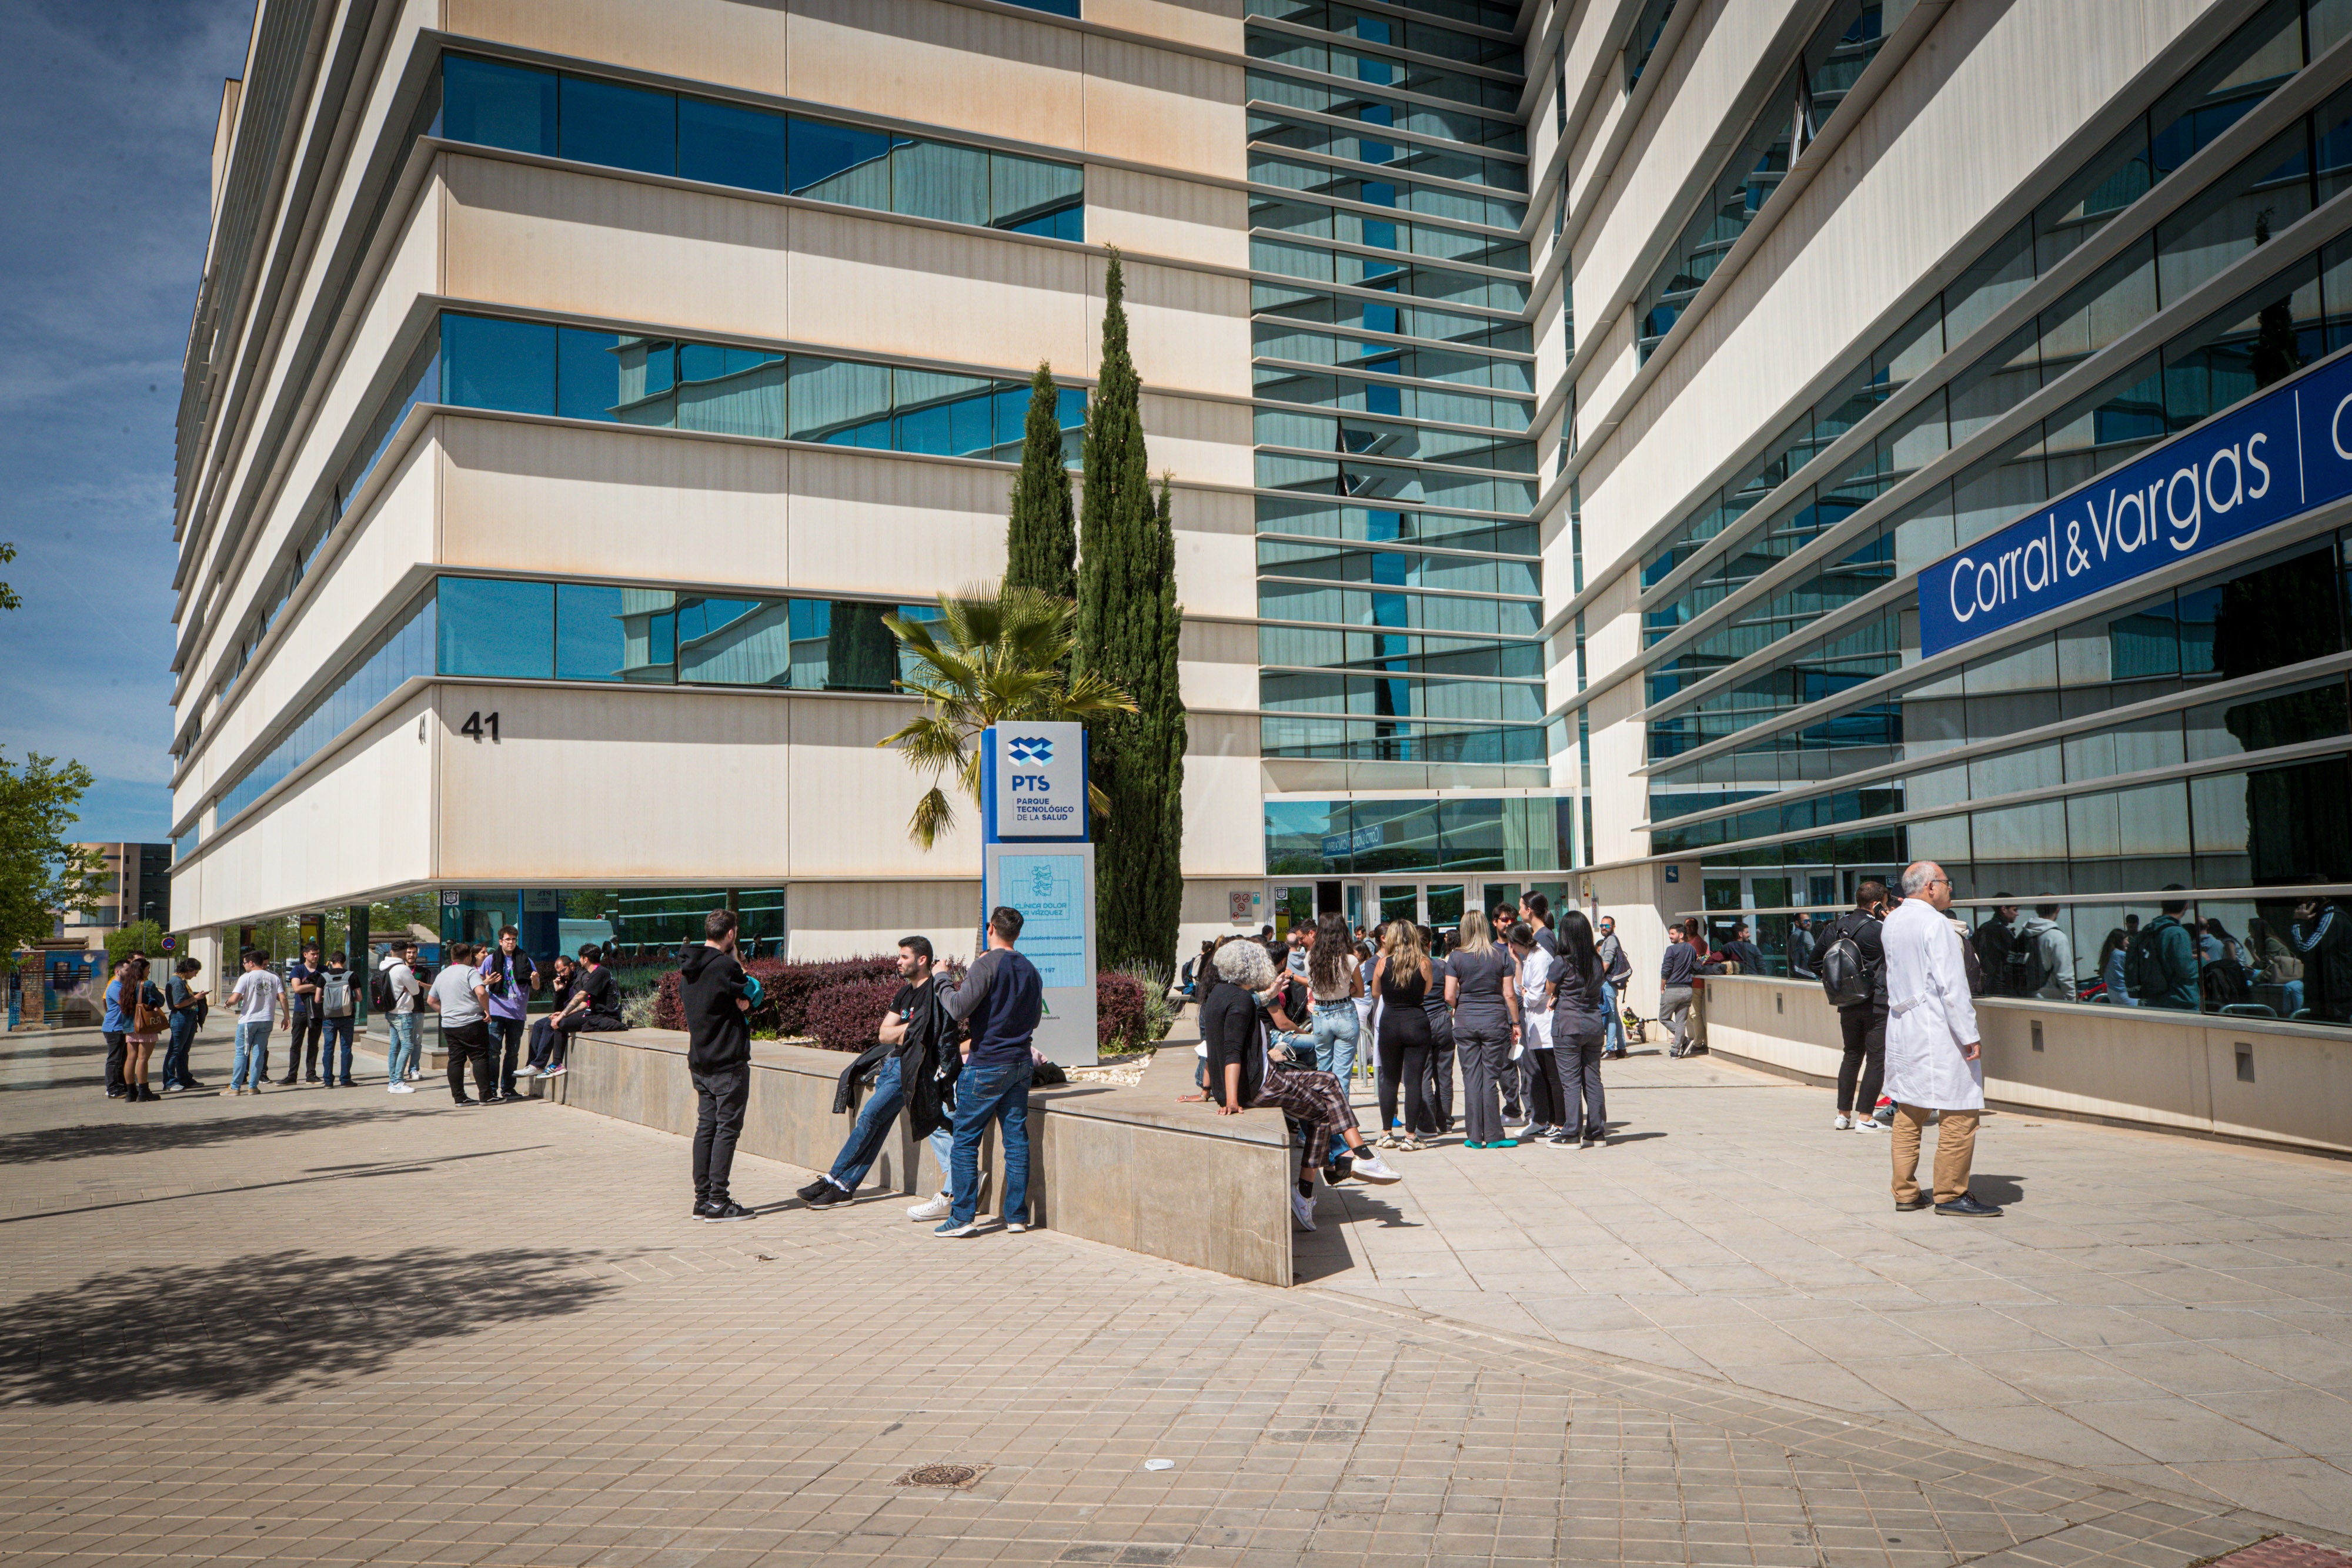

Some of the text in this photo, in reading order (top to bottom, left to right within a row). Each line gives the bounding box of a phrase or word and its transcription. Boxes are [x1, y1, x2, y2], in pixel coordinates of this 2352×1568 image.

[1950, 513, 2058, 623] Corral
[2066, 520, 2092, 577] &
[2087, 433, 2270, 551] Vargas
[461, 711, 499, 741] 41
[1012, 775, 1050, 791] PTS
